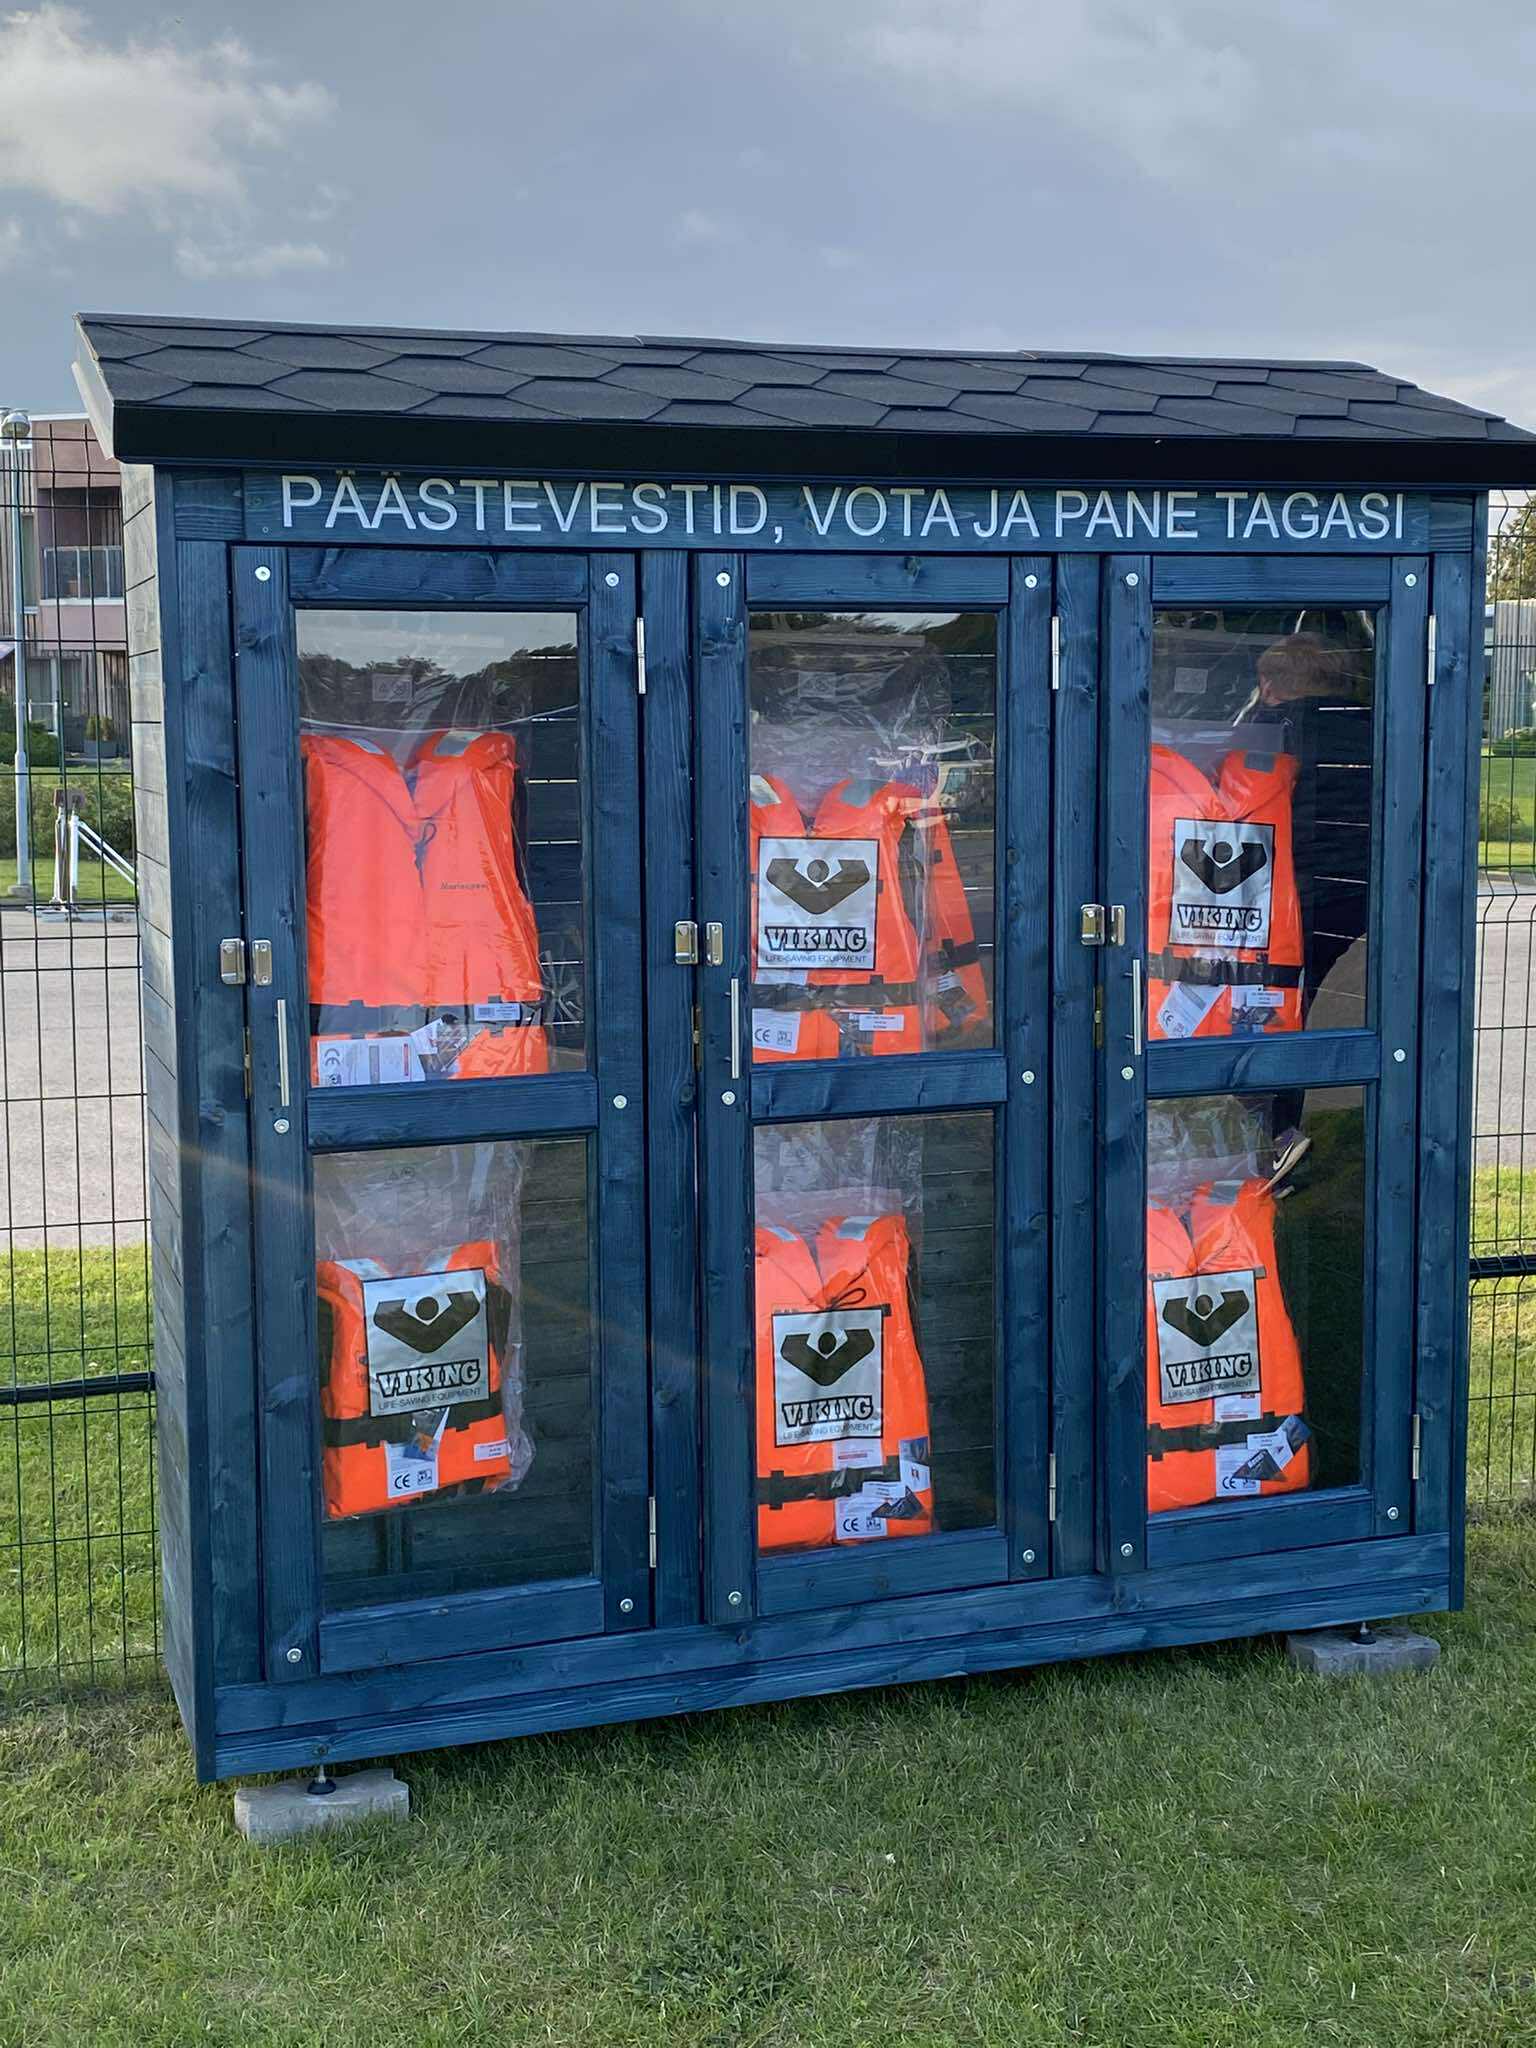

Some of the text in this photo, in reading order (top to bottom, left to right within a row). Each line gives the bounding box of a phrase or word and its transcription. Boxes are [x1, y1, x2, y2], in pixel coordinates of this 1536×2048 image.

[281, 470, 1405, 545] PÄÄSTEVESTID, VOTA JA PANE TAGASI
[1176, 904, 1262, 931] VIKING
[764, 926, 867, 952] VIKING
[376, 1359, 480, 1398] VIKING
[1166, 1353, 1252, 1388] VIKING
[781, 1395, 874, 1428] VIKING
